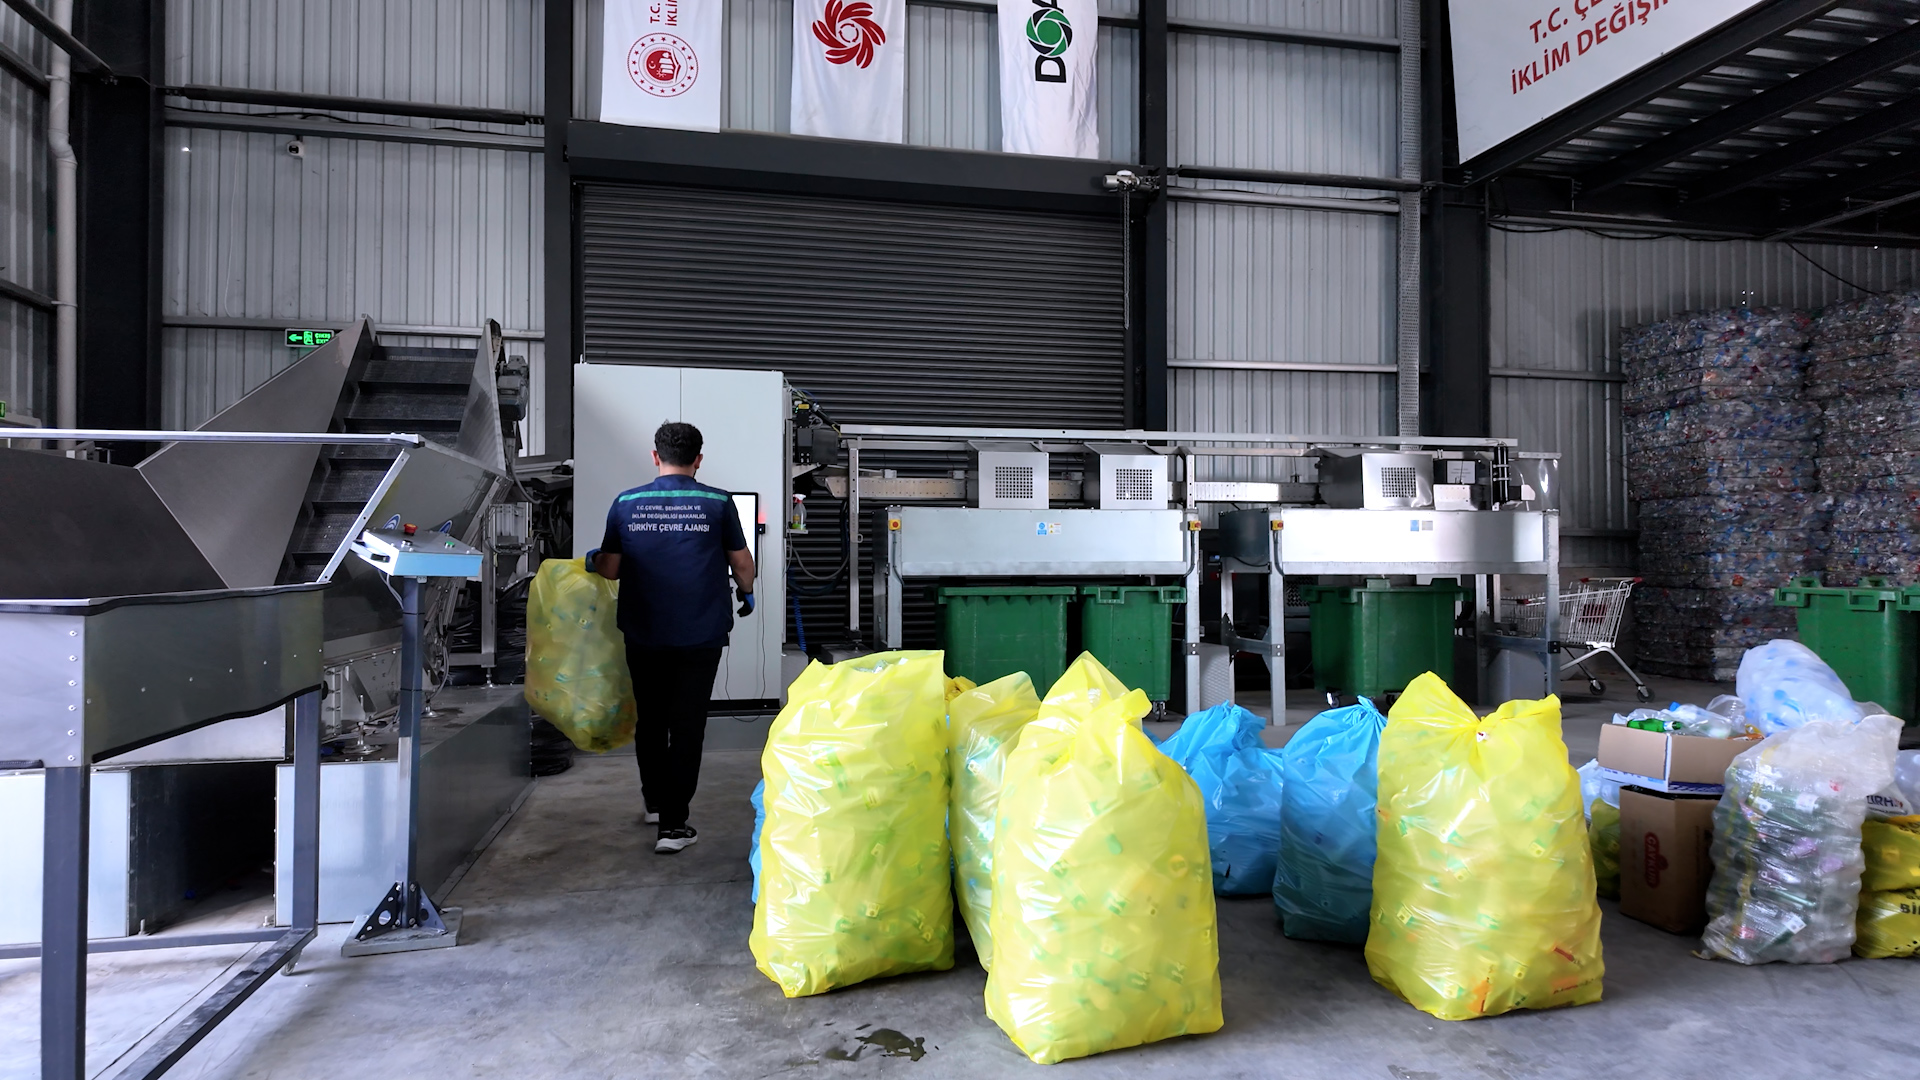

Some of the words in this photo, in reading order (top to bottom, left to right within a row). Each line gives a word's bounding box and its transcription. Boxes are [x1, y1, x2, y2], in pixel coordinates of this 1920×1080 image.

[650, 3, 661, 24] T.C.
[665, 0, 678, 26] İKLİ
[1529, 7, 1568, 44] T.C.
[1511, 41, 1570, 95] İKLİM
[1576, 0, 1669, 56] DEĞİŞ
[628, 522, 657, 532] TÜRKİYE
[659, 523, 683, 533] ÇEVRE
[684, 523, 710, 532] AJANSI
